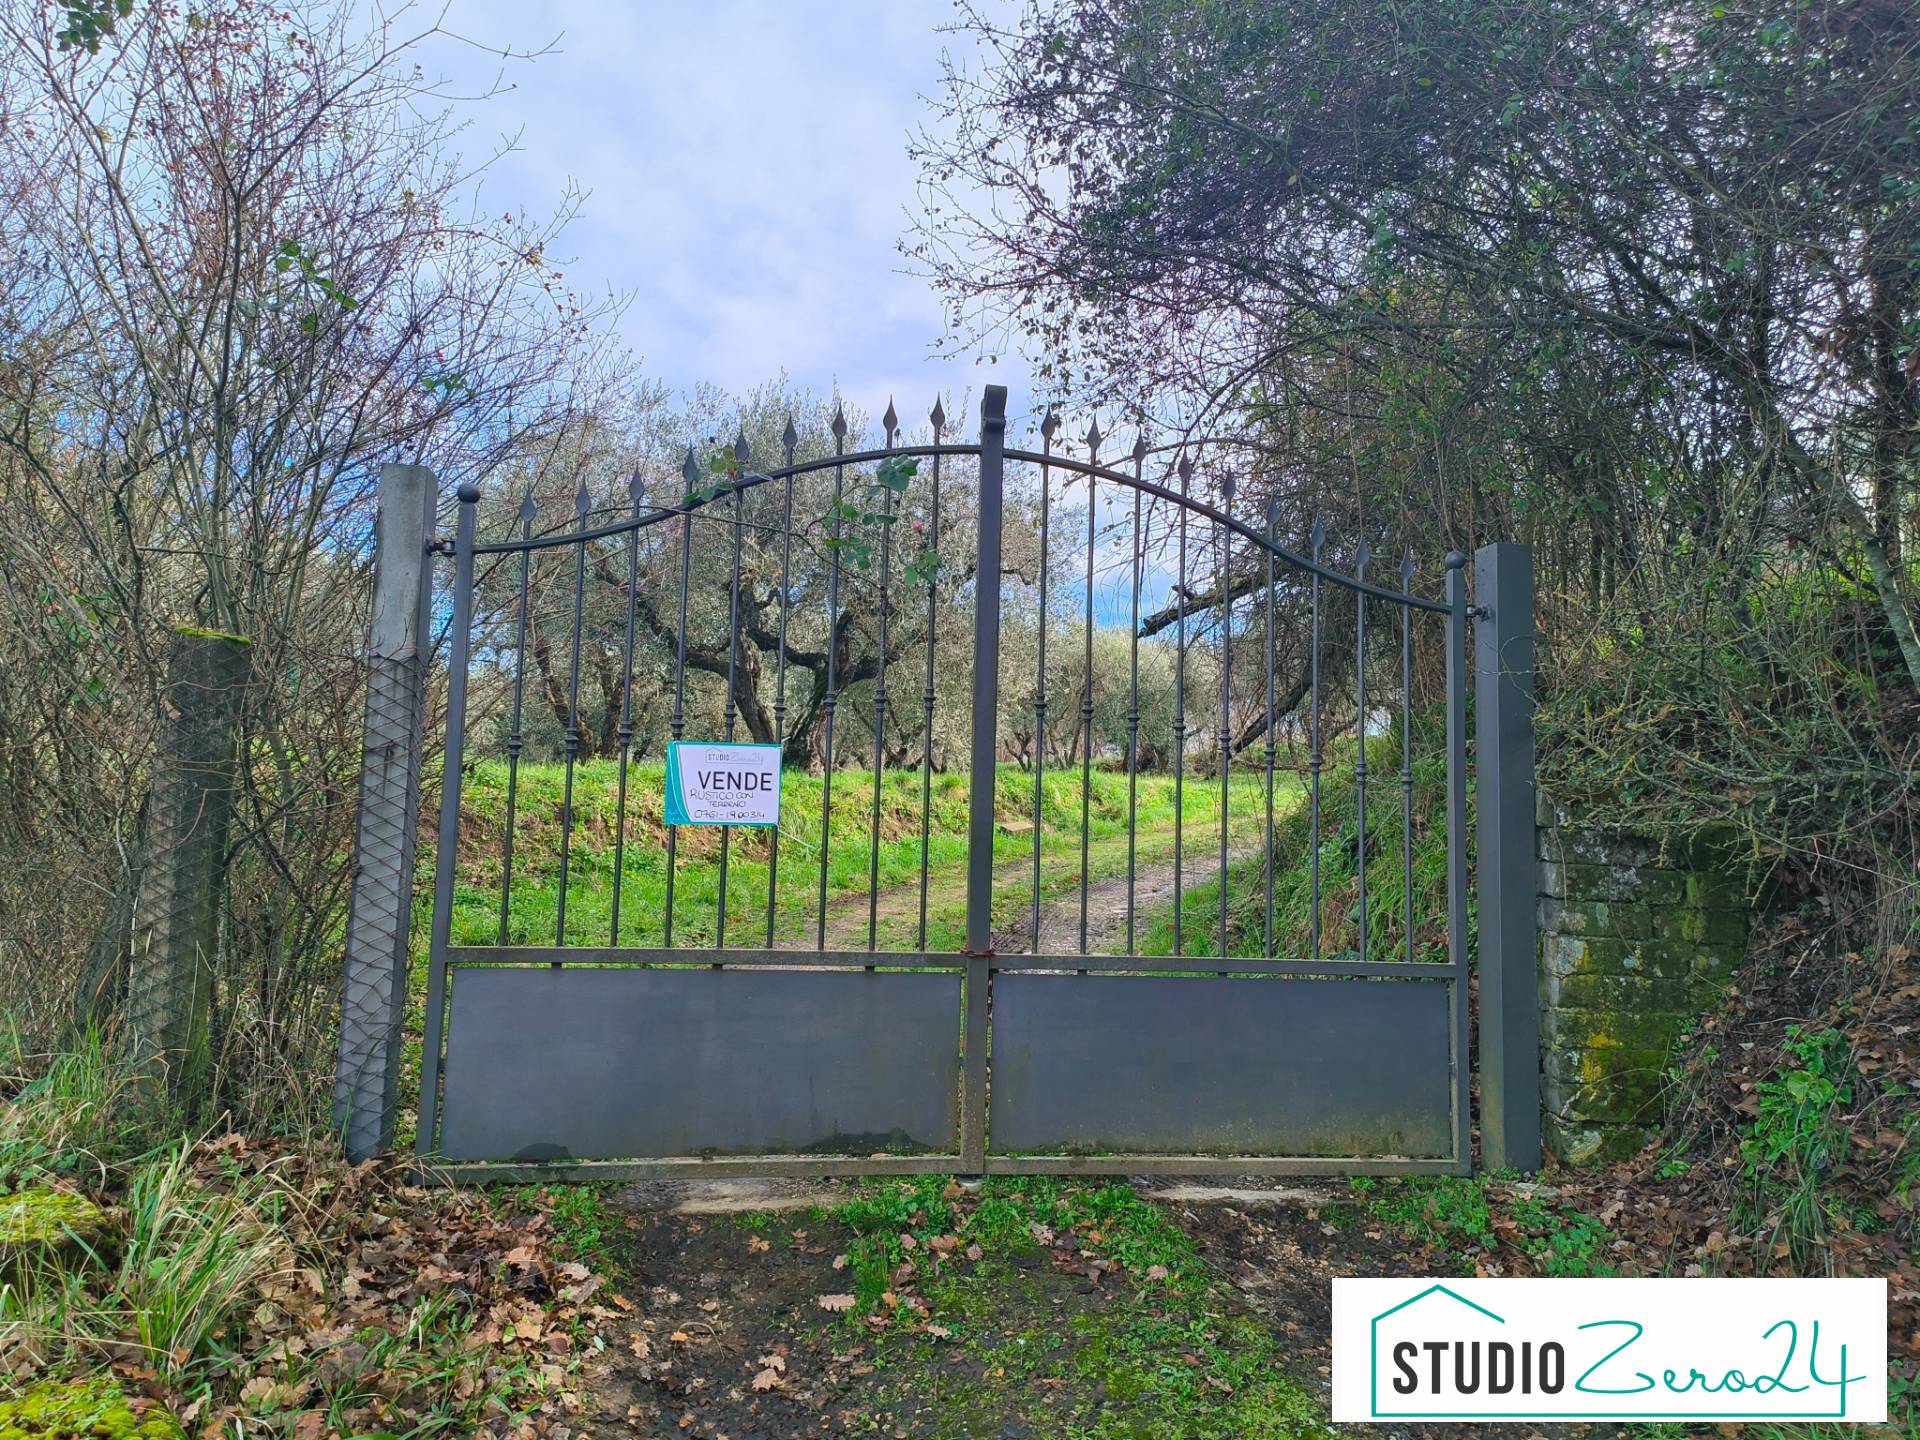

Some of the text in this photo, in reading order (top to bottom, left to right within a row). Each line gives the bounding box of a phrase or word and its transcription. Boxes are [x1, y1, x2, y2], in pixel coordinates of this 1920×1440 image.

[708, 753, 730, 761] STUDIO
[698, 771, 773, 791] VENDE
[689, 788, 754, 801] RUSTICO CON
